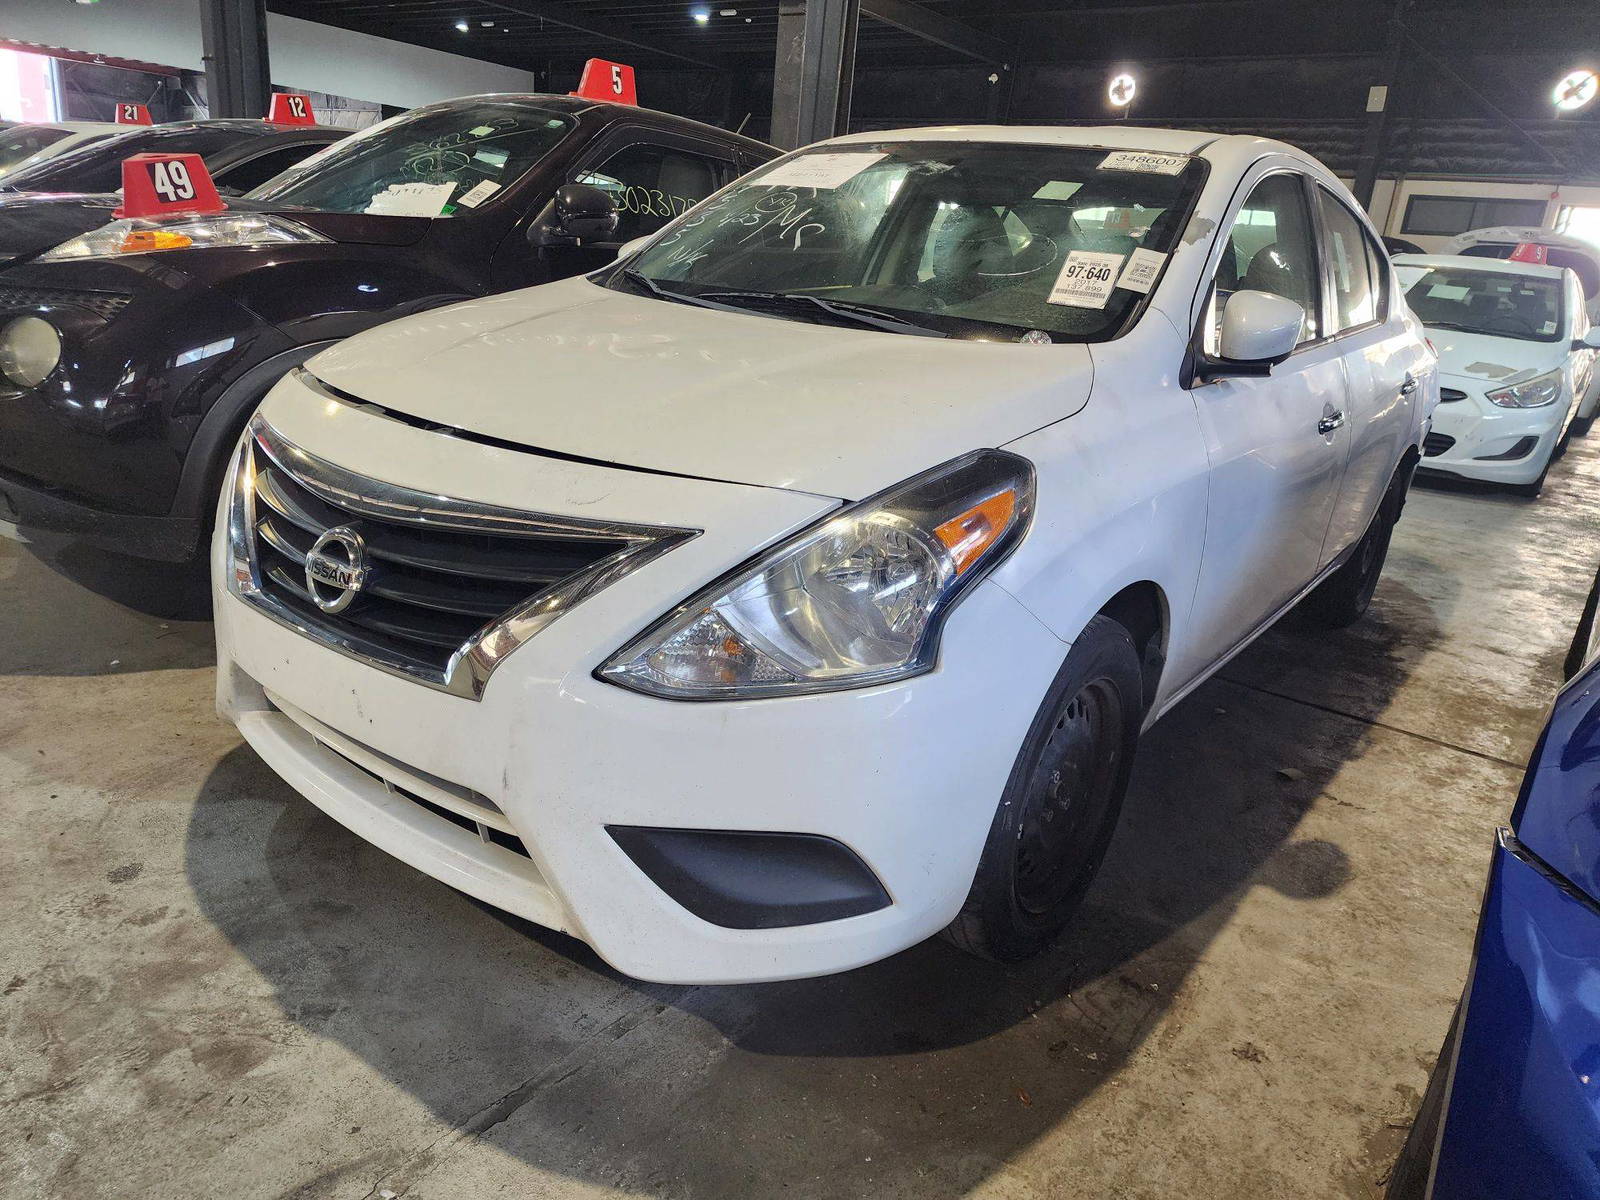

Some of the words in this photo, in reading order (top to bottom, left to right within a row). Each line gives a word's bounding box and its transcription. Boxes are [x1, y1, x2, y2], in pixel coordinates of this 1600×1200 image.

[611, 65, 622, 95] 5
[124, 104, 138, 121] 21
[288, 97, 307, 118] 12
[1115, 154, 1183, 167] 3486007
[154, 160, 195, 202] 49
[1066, 265, 1111, 282] 97:640
